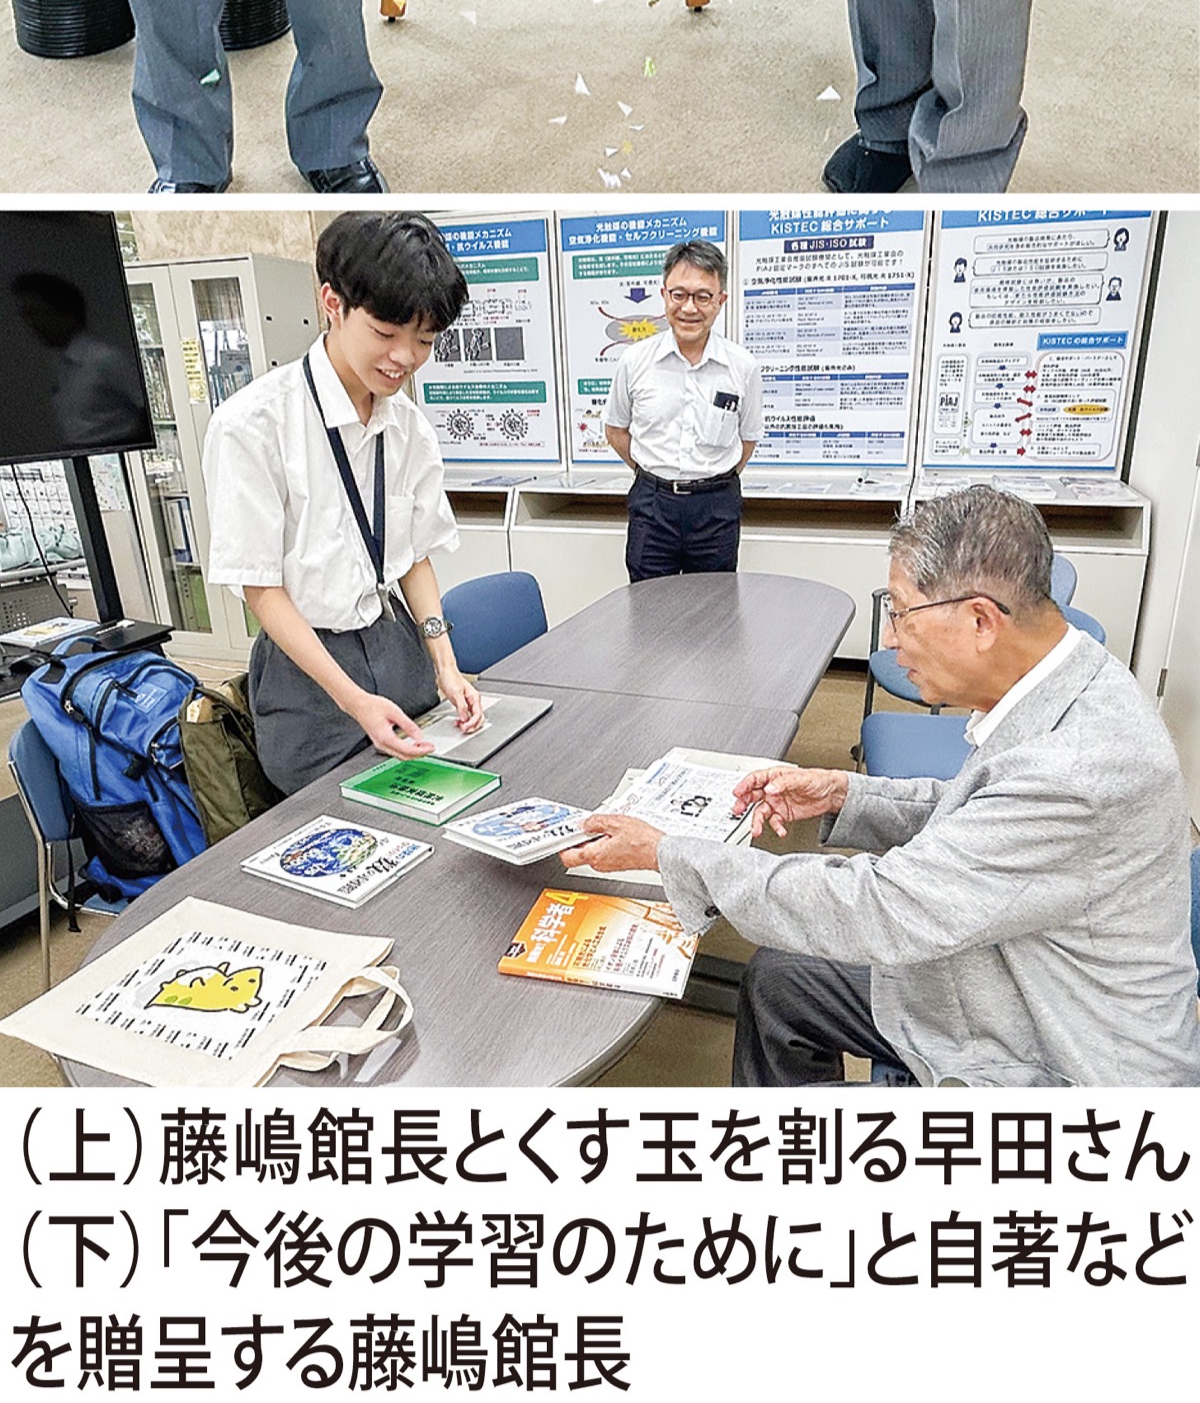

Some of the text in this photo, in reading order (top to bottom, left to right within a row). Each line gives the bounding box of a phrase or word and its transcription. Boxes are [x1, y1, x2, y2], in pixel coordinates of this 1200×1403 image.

[976, 210, 1032, 222] KISTEC
[771, 216, 889, 235] KISTEC 総合サポート
[545, 891, 590, 906] 4
